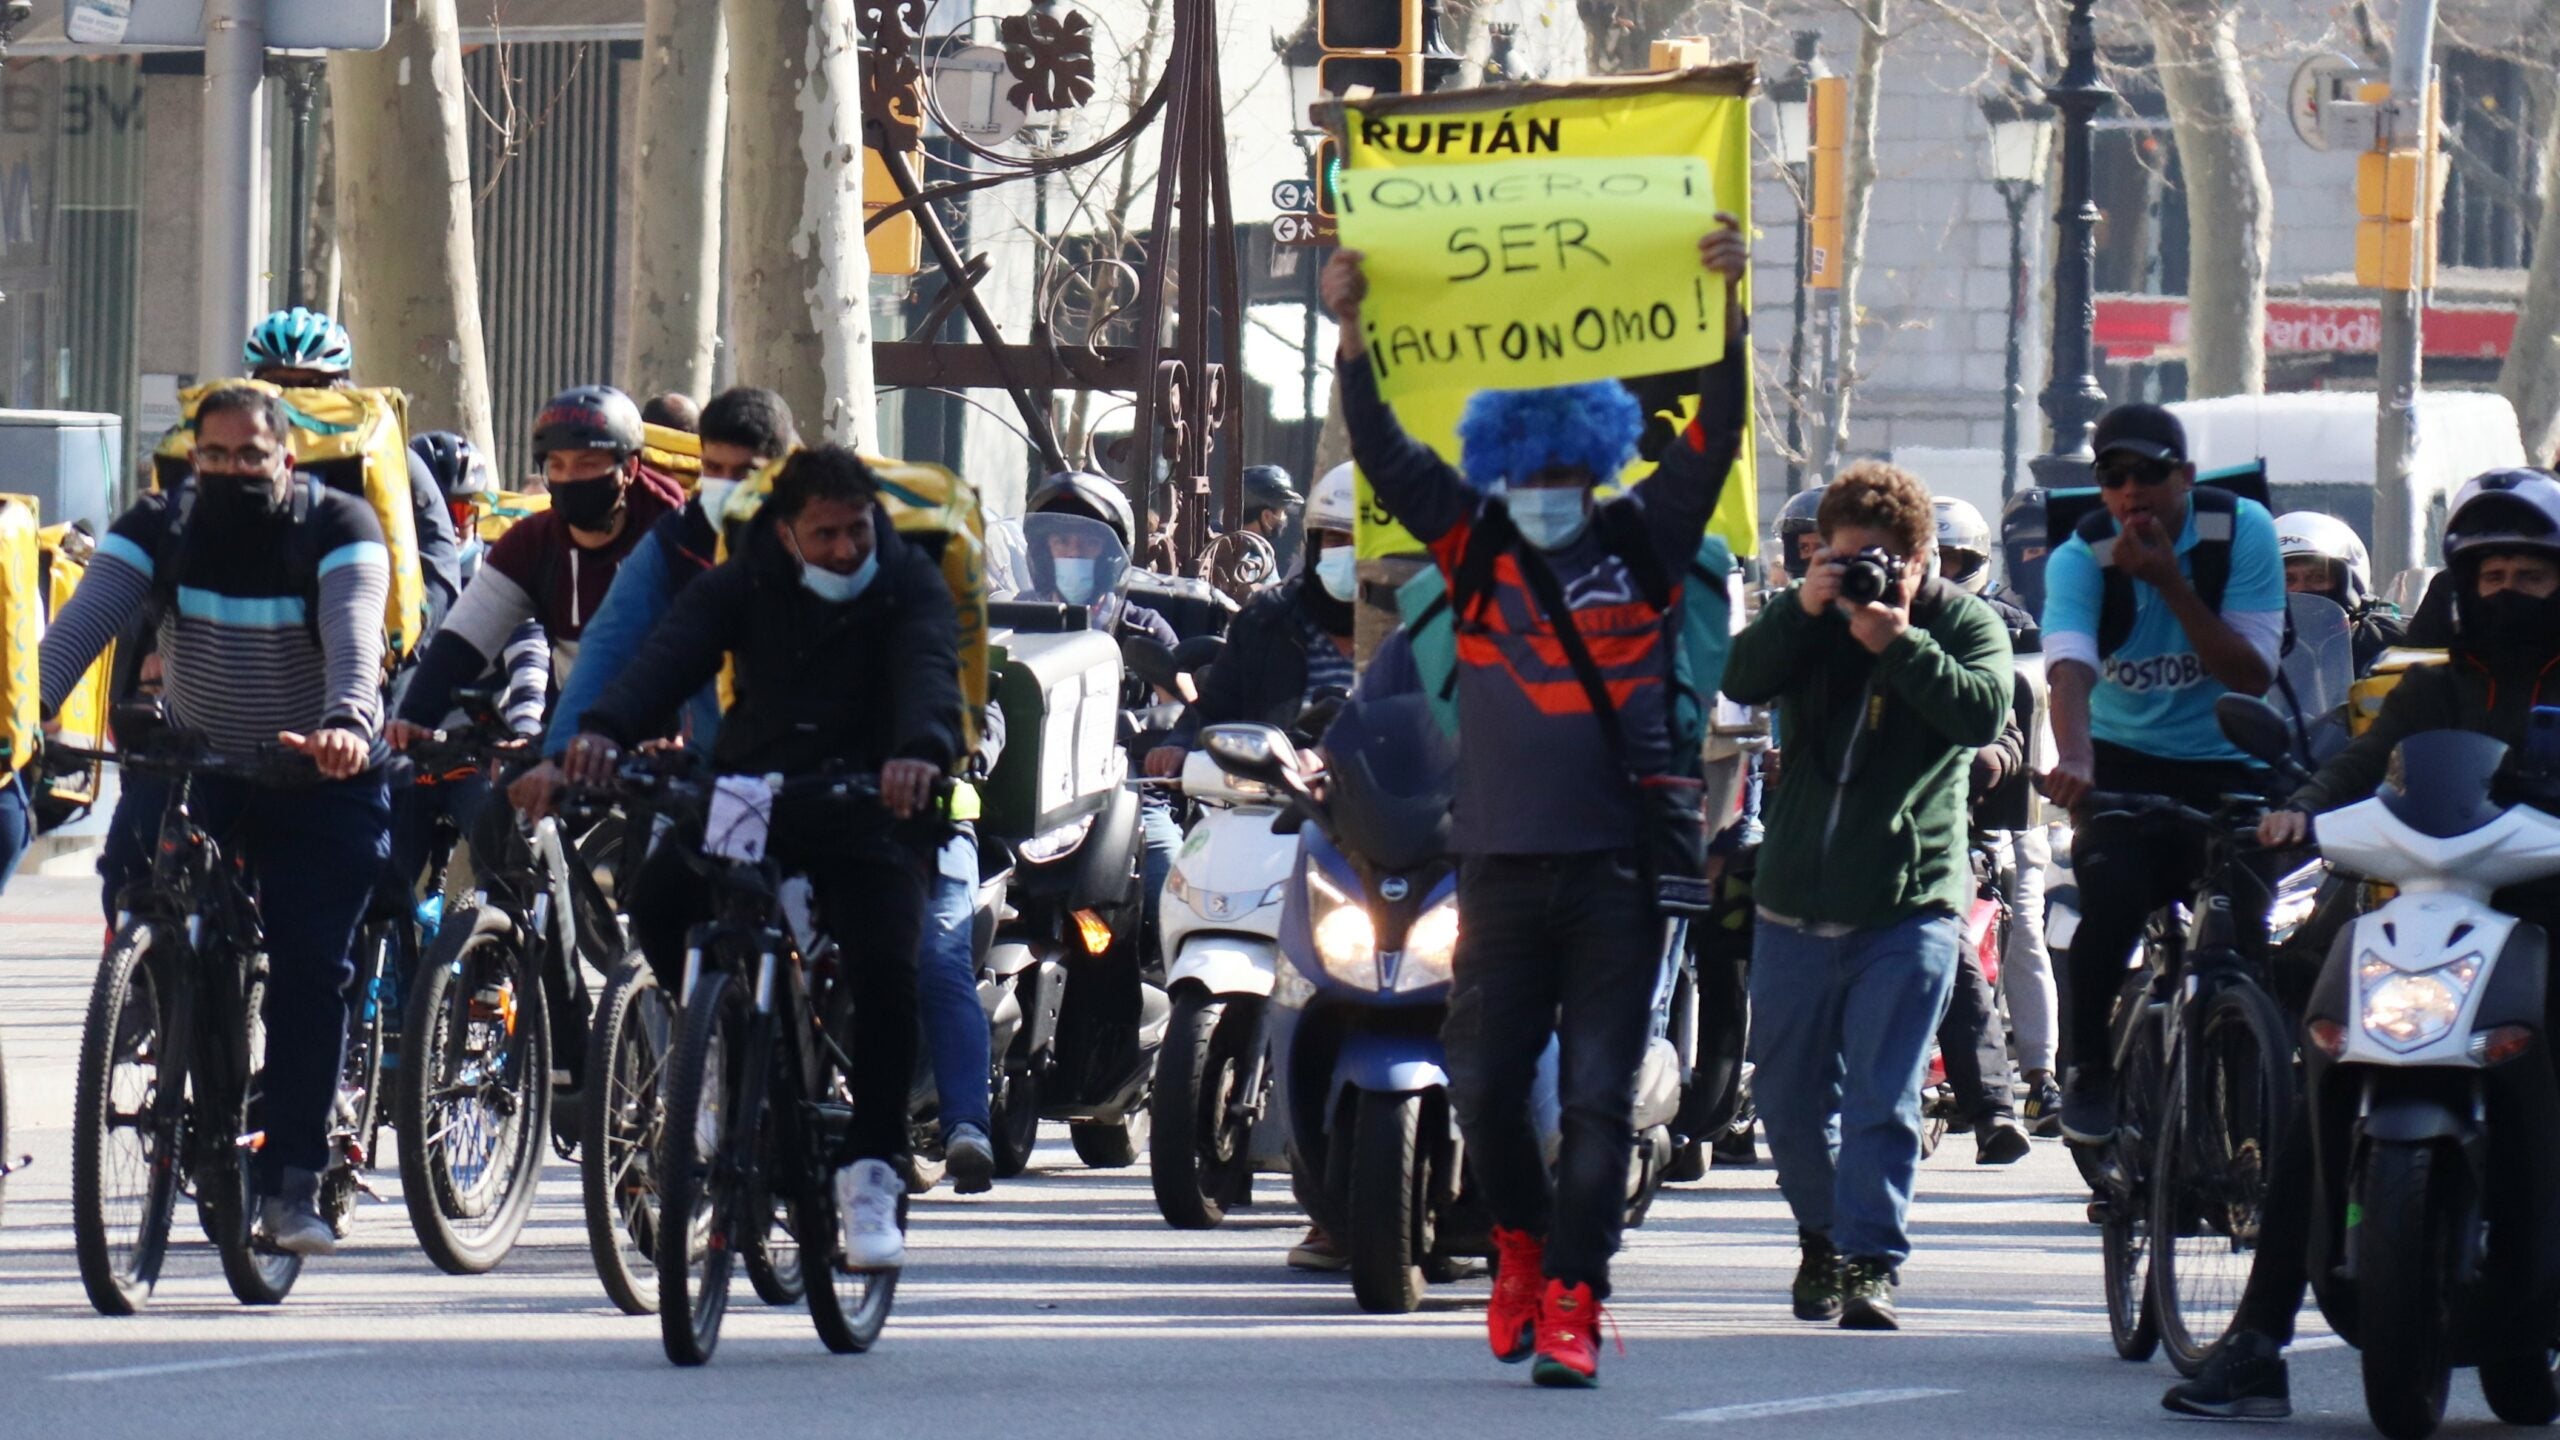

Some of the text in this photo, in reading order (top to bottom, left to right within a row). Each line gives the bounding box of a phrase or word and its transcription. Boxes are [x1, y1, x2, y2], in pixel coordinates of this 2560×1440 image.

[1361, 111, 1561, 154] RUFIÁN
[1447, 218, 1611, 283] SER
[2264, 309, 2381, 352] eriódi
